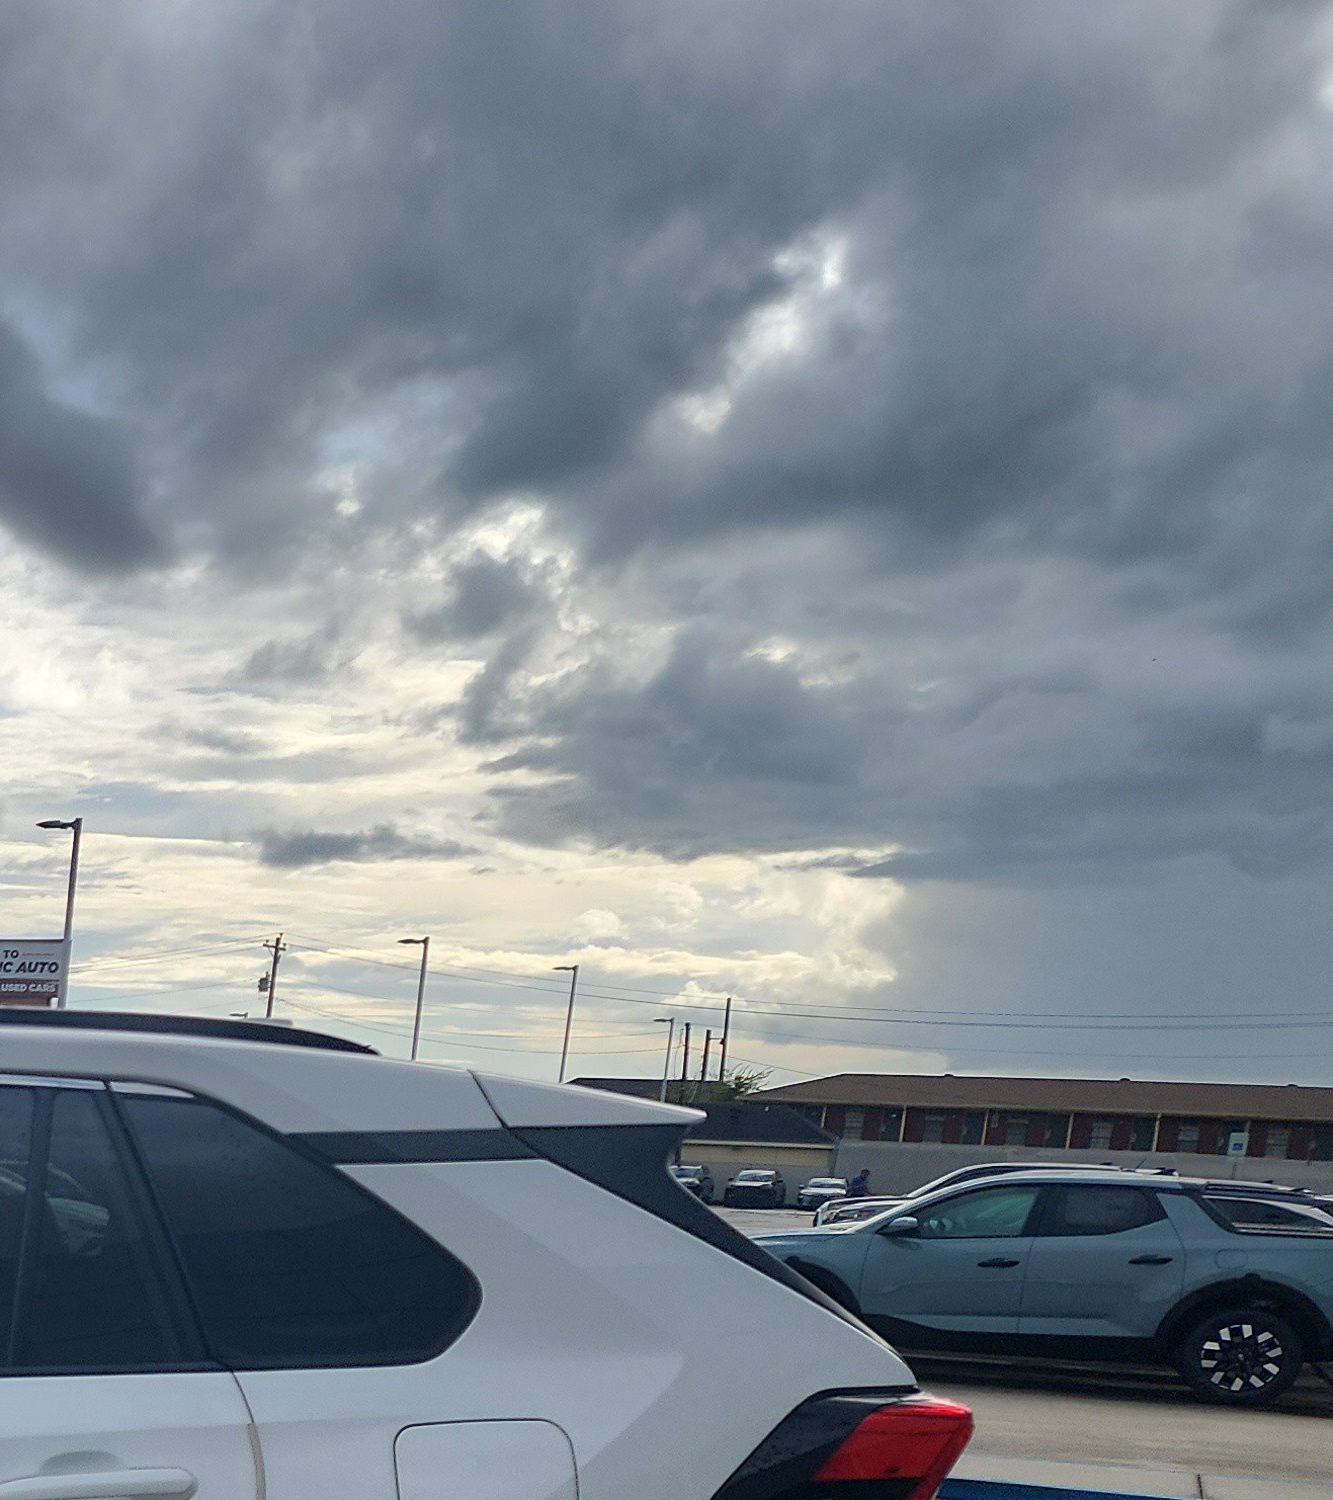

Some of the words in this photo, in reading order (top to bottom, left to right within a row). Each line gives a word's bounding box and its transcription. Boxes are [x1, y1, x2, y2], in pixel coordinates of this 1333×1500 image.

[3, 950, 19, 959] TO
[15, 961, 60, 974] AUTO
[2, 982, 27, 992] USED
[29, 982, 56, 992] CARS
